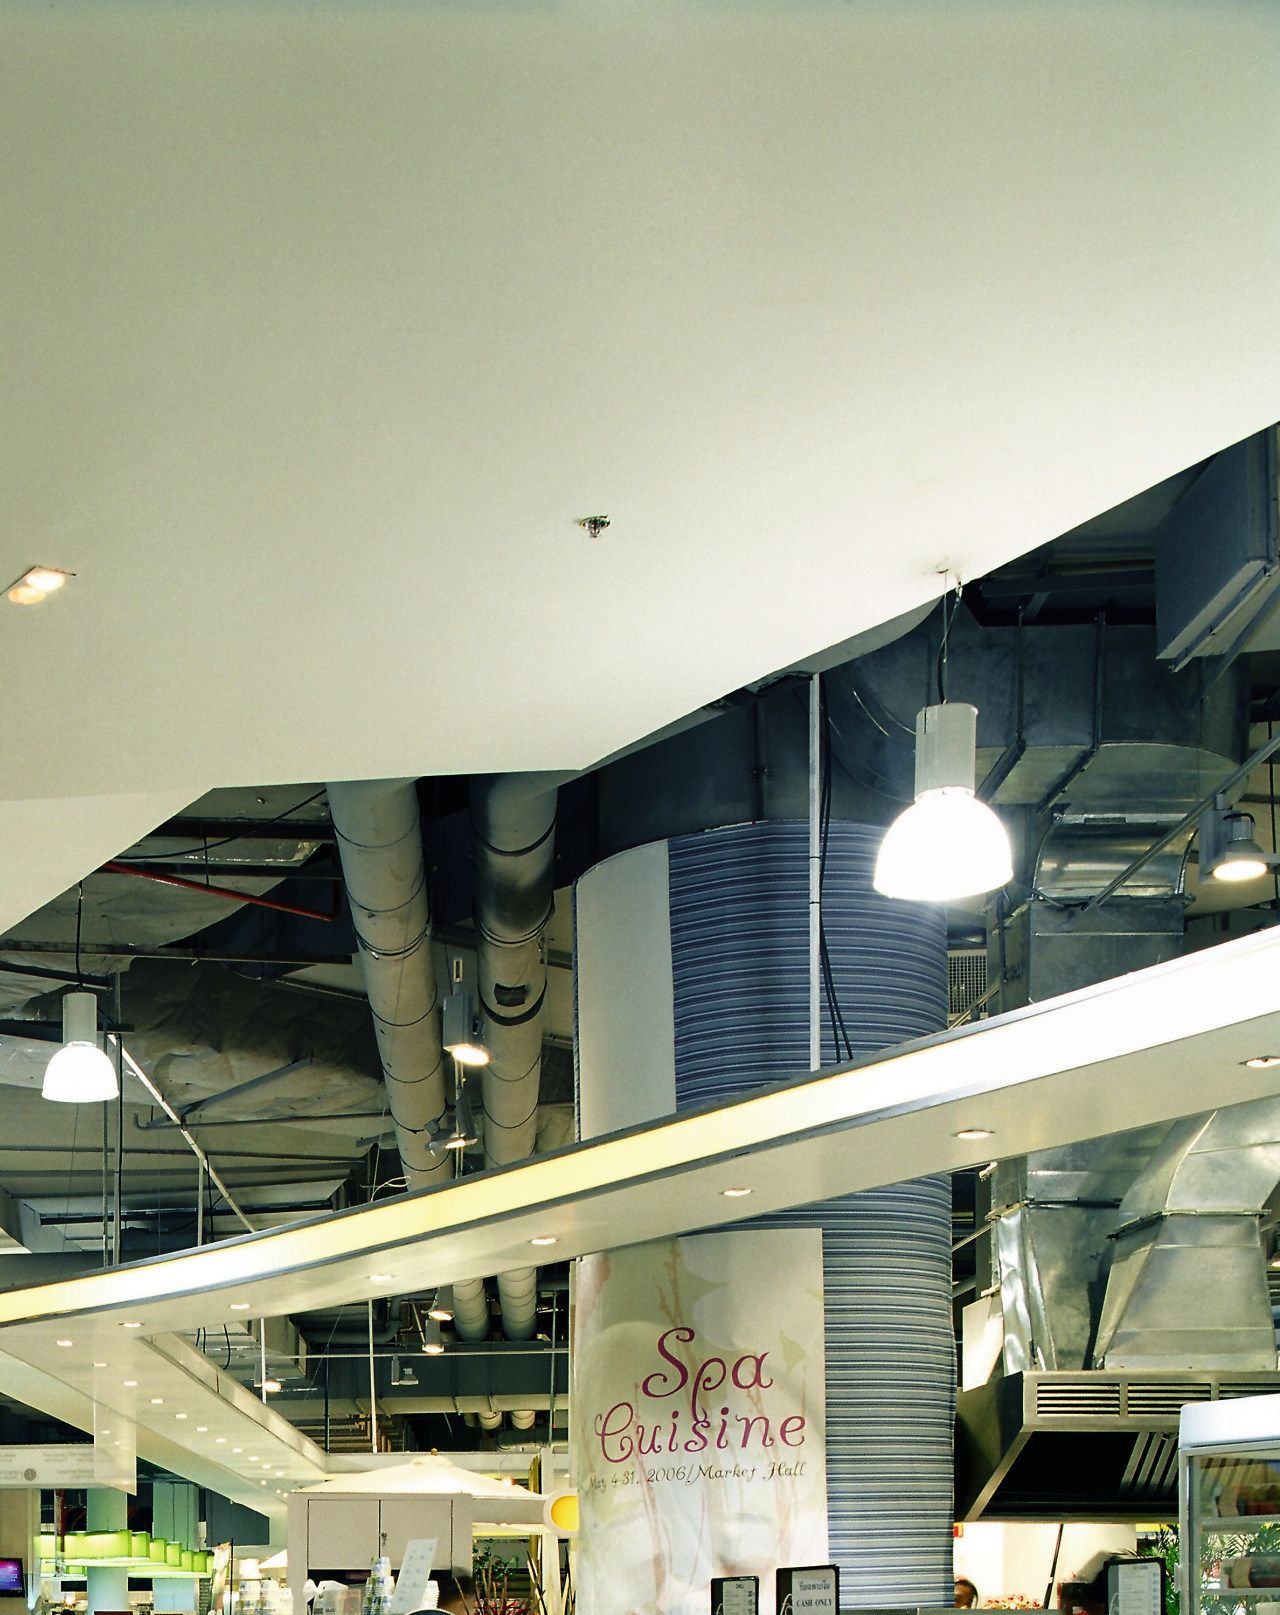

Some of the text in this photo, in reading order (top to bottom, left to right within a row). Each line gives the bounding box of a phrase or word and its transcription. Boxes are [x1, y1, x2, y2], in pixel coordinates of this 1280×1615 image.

[641, 1326, 773, 1424] Spa
[594, 1401, 806, 1464] Cuisine
[763, 1461, 807, 1480] Hall
